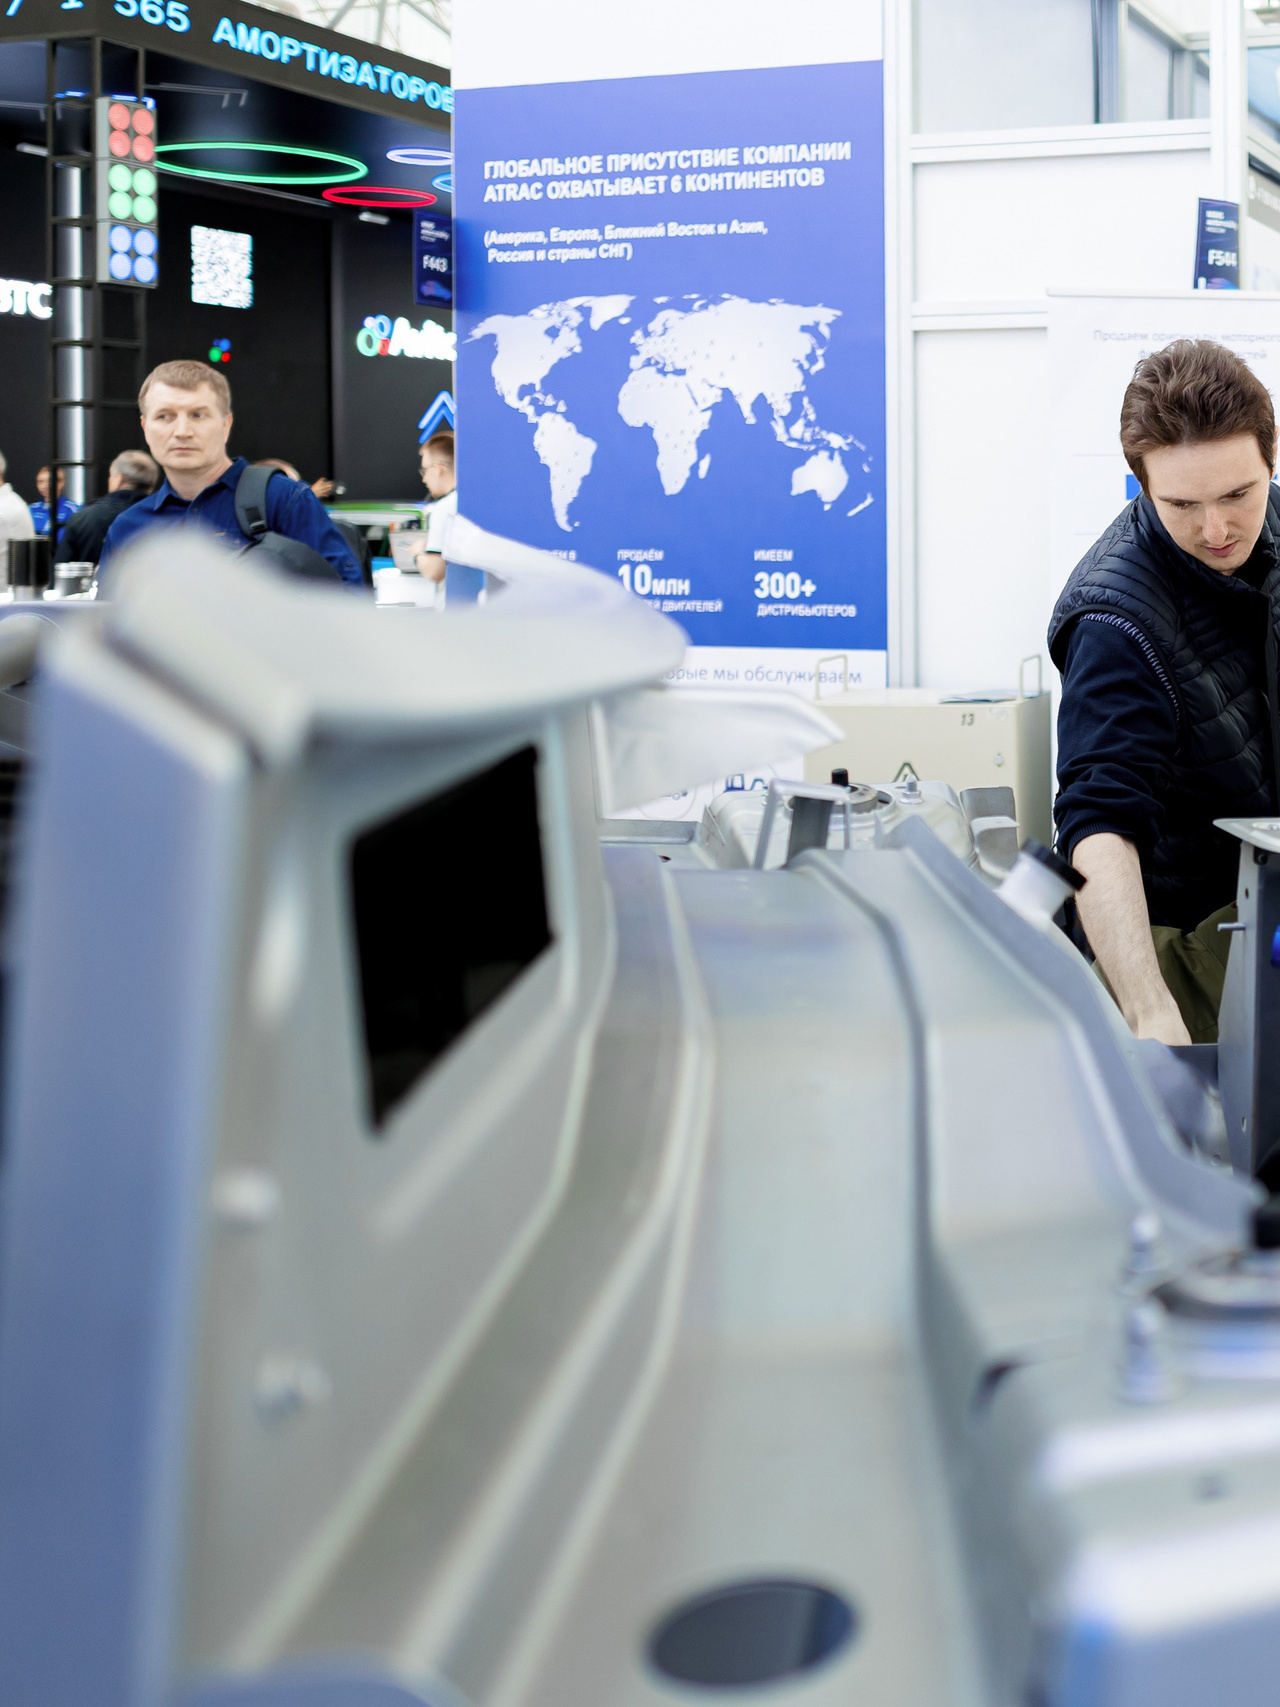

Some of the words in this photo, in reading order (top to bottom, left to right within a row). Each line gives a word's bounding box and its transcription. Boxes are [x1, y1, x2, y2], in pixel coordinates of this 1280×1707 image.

[484, 155, 604, 179] ГЛОБАЛЬНОЕ
[606, 147, 740, 172] ПРИСУТСТВИЕ
[743, 141, 852, 165] КОМПАНИИ
[483, 182, 544, 202] ATRAC
[546, 175, 668, 199] ОХВАТЫВАЕТ
[670, 175, 682, 193] 6
[685, 167, 825, 192] КОНТИНЕНТОВ
[484, 230, 548, 248] (Америка,
[549, 227, 603, 244] Европа,
[604, 223, 666, 240] Ближний
[667, 222, 716, 237] Восток
[717, 223, 728, 235] и
[729, 219, 769, 235] Азия,
[487, 249, 535, 263] Россия
[536, 250, 546, 261] и
[548, 248, 597, 263] страны
[599, 242, 633, 260] СНГ)
[1207, 248, 1238, 267] F544
[422, 254, 449, 273] F443
[754, 549, 793, 561] ИМЕЕМ
[754, 571, 817, 599] 300+
[662, 599, 723, 613] ДВИГАТЕЛЕЙ
[713, 668, 739, 681] мы
[961, 712, 975, 727] 13
